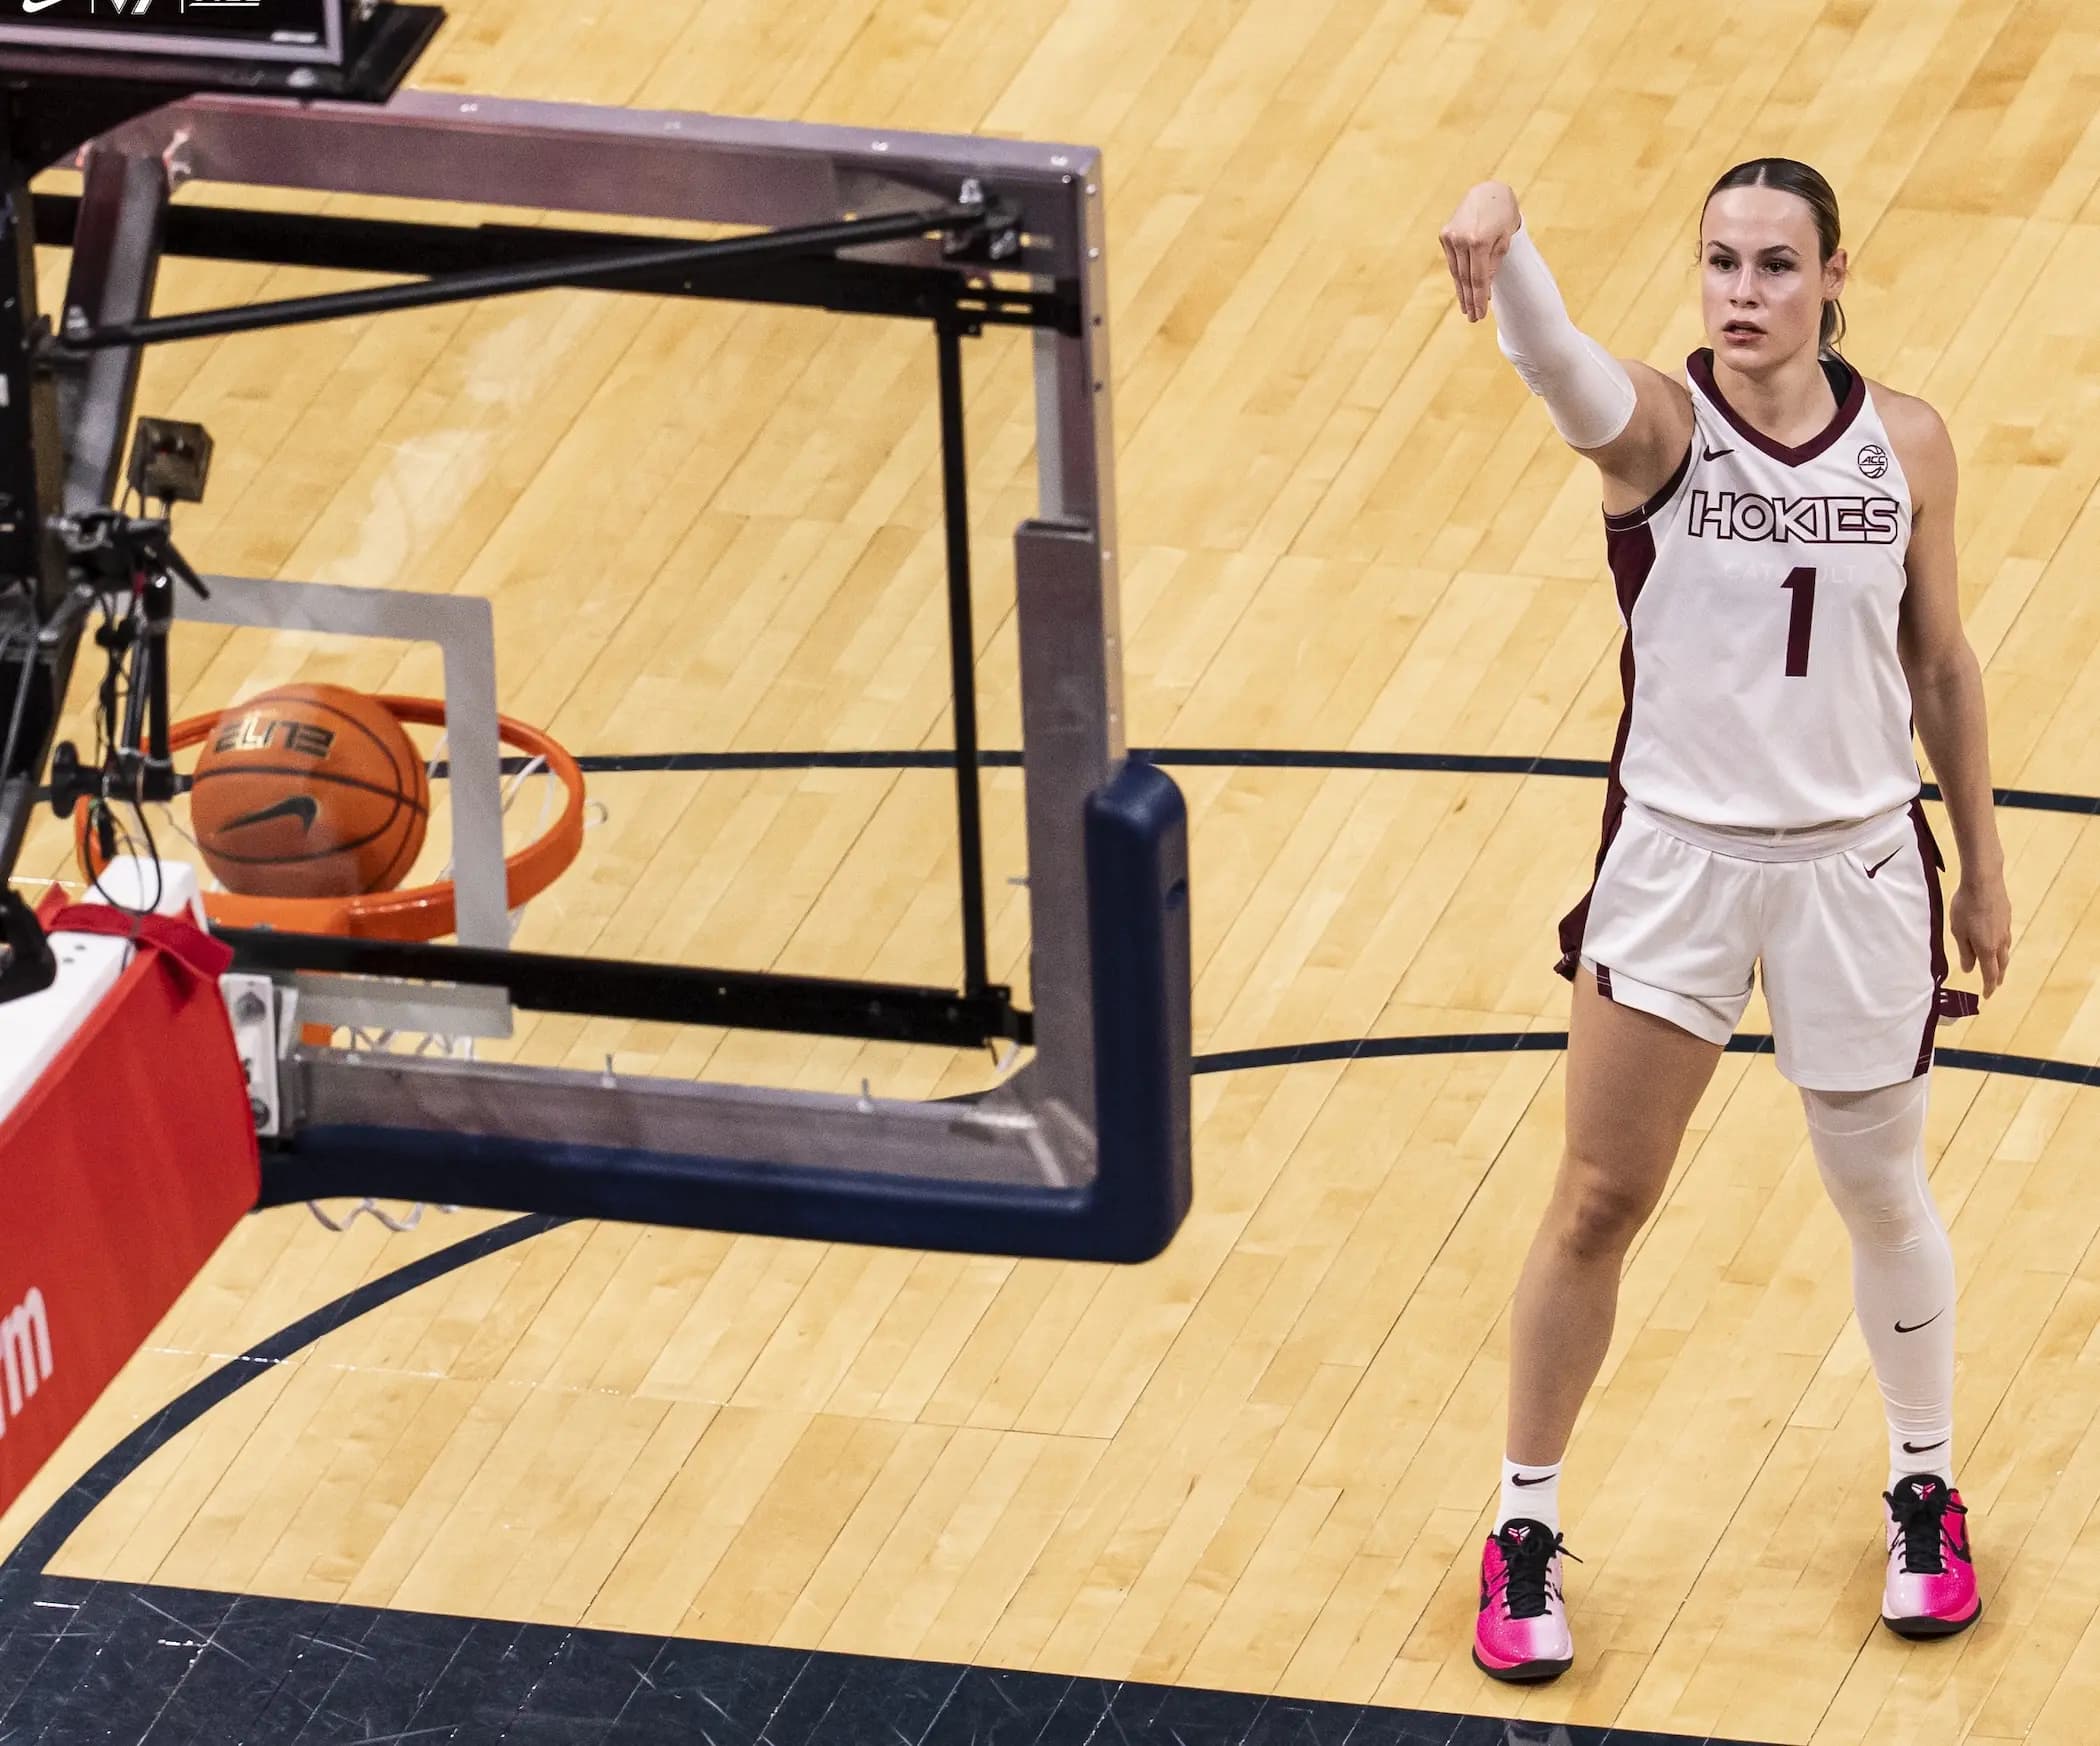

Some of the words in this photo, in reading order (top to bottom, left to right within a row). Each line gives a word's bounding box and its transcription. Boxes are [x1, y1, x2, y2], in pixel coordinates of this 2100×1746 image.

[1688, 490, 1899, 544] HOKIES
[1724, 560, 1858, 584] CATULT
[1780, 566, 1817, 678] 1
[214, 715, 335, 757] ELITE
